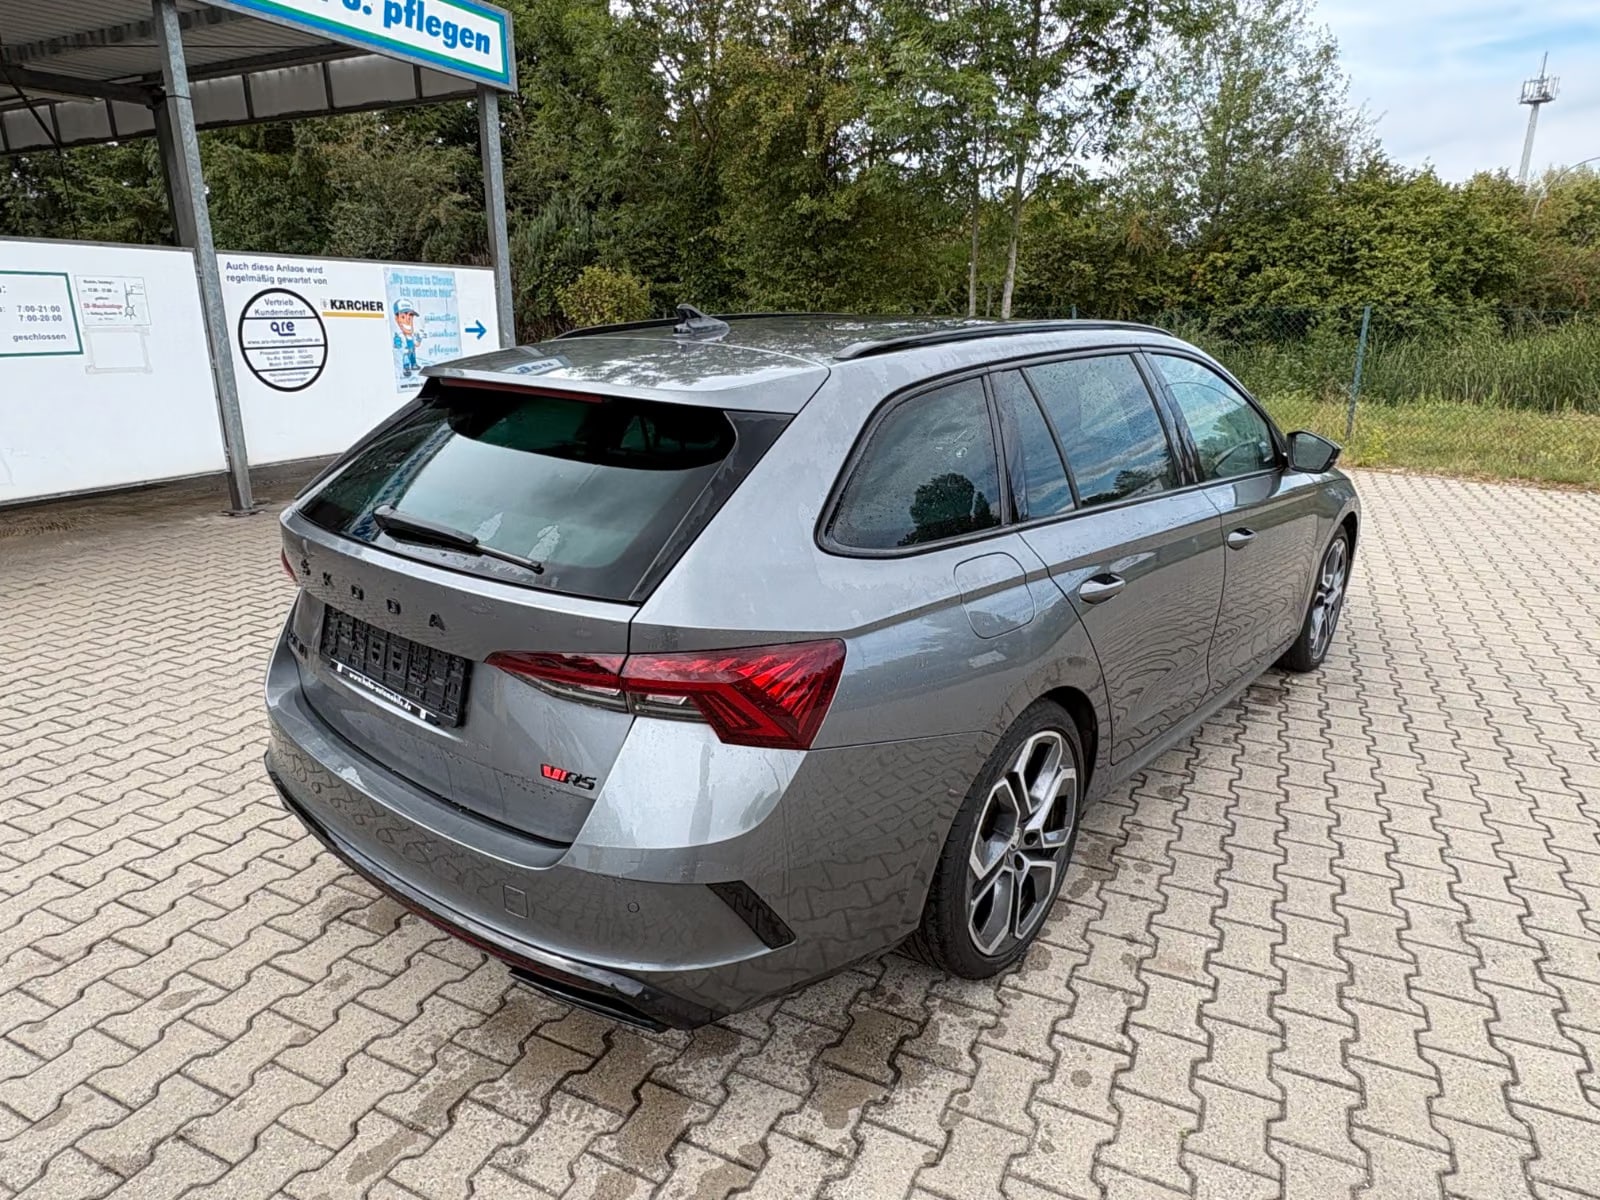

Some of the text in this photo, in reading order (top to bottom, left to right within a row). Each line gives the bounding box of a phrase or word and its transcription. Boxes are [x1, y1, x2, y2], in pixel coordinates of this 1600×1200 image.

[383, 0, 491, 55] pflegen
[226, 261, 249, 271] Auch
[251, 262, 274, 272] diese
[306, 265, 323, 274] wird
[226, 274, 275, 285] regelmäßig
[277, 276, 312, 285] gewartet
[264, 298, 294, 306] Vertrieb
[12, 333, 67, 342] geschlossen
